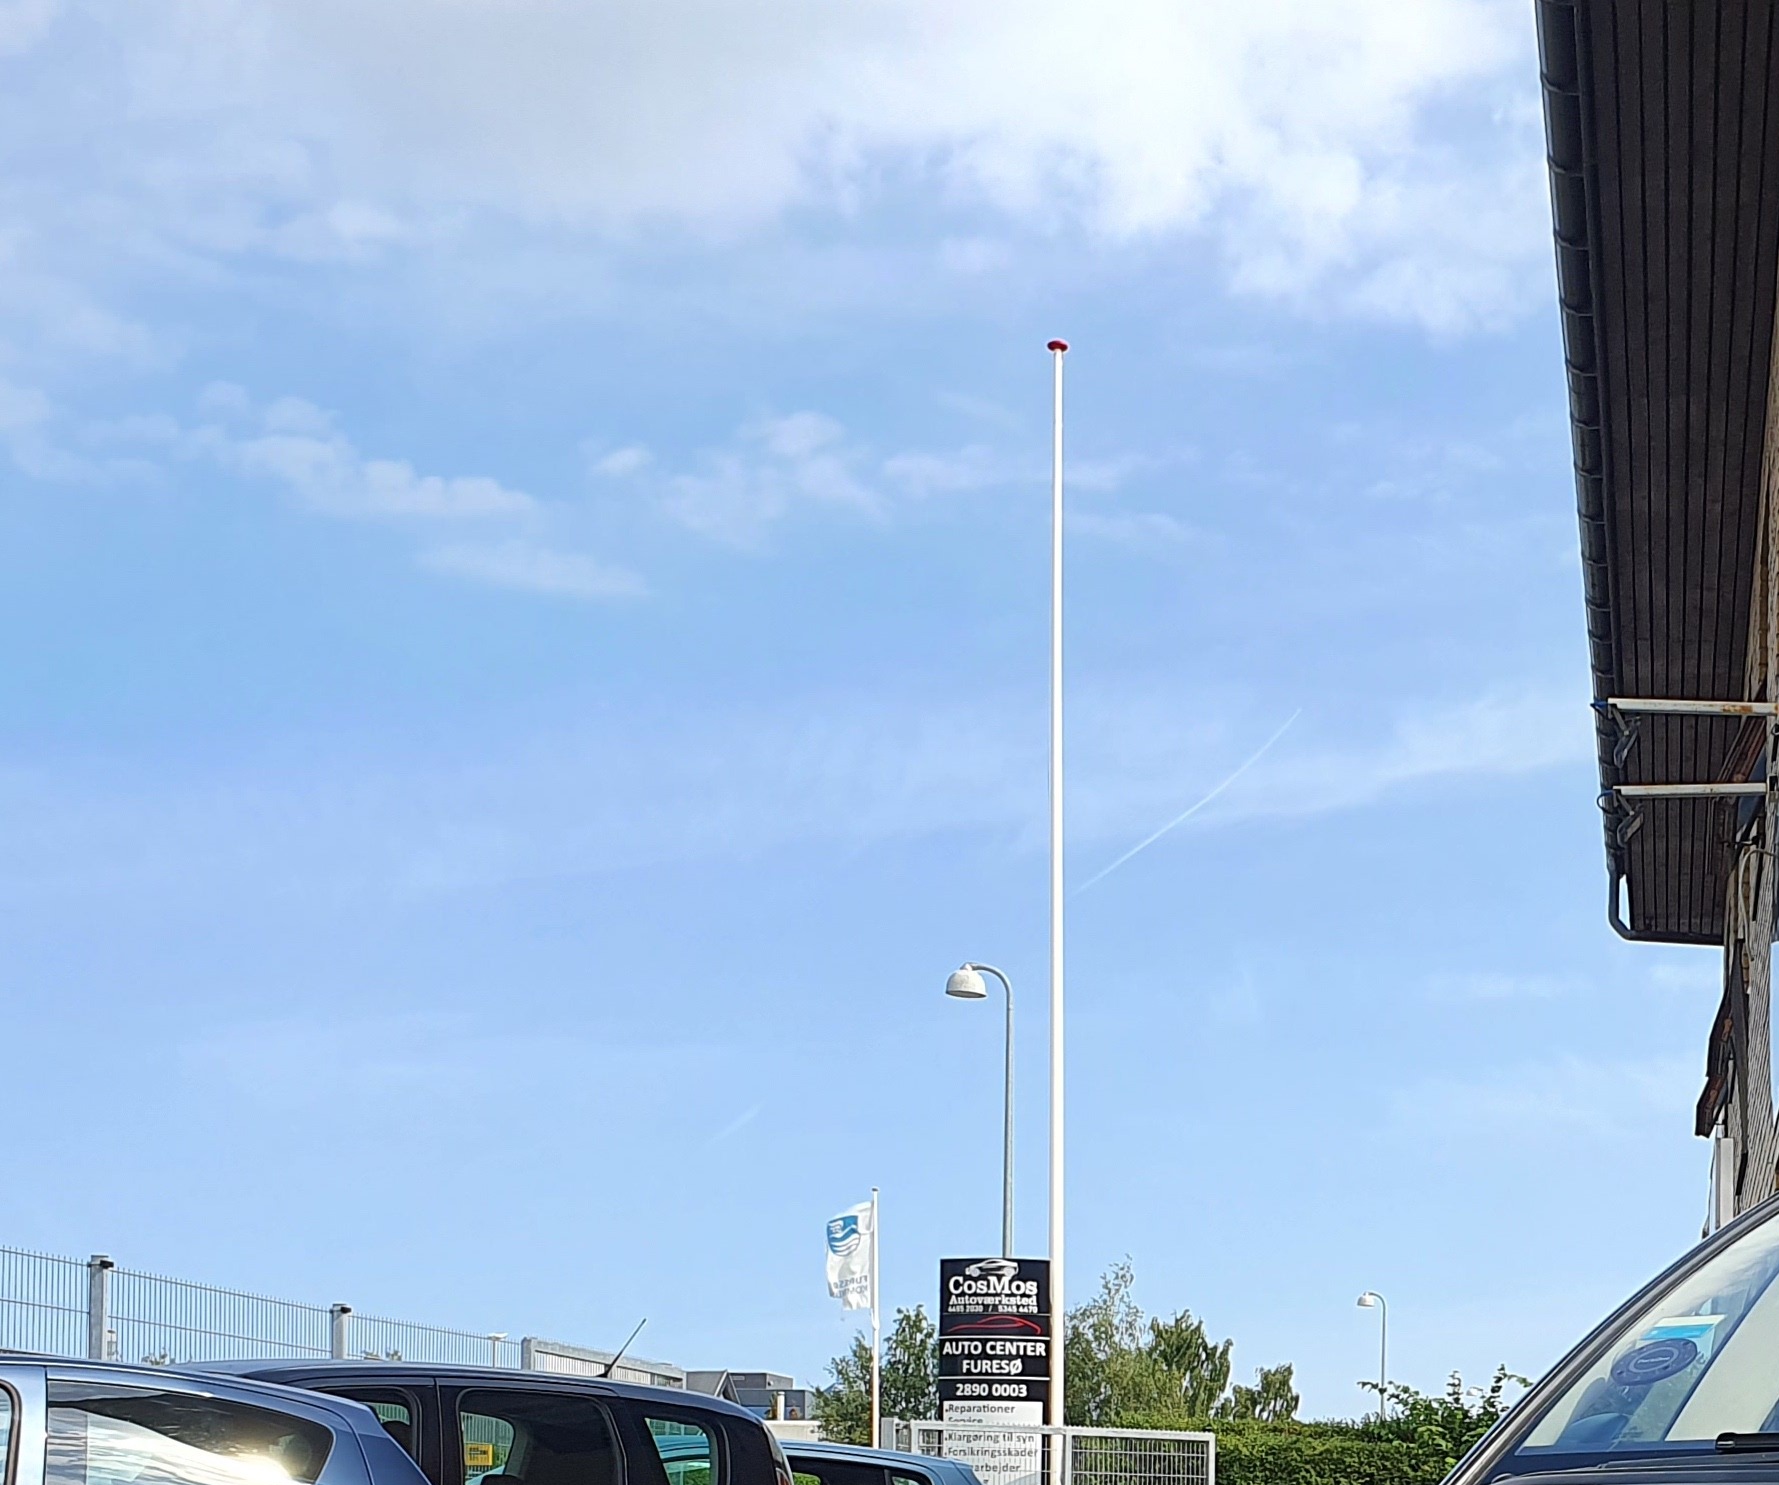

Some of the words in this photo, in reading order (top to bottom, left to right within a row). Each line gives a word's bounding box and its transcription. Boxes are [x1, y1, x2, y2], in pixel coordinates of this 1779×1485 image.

[948, 1275, 1038, 1295] CosMos
[949, 1295, 1037, 1306] Autoværksted
[943, 1341, 982, 1355] AUTO
[986, 1341, 1046, 1356] CENTER
[962, 1358, 1023, 1375] FURESØ
[955, 1383, 989, 1397] 2890
[991, 1384, 1027, 1397] 0003
[948, 1404, 1016, 1415] Reparationer
[1002, 1432, 1013, 1442] til
[1016, 1434, 1035, 1444] syn
